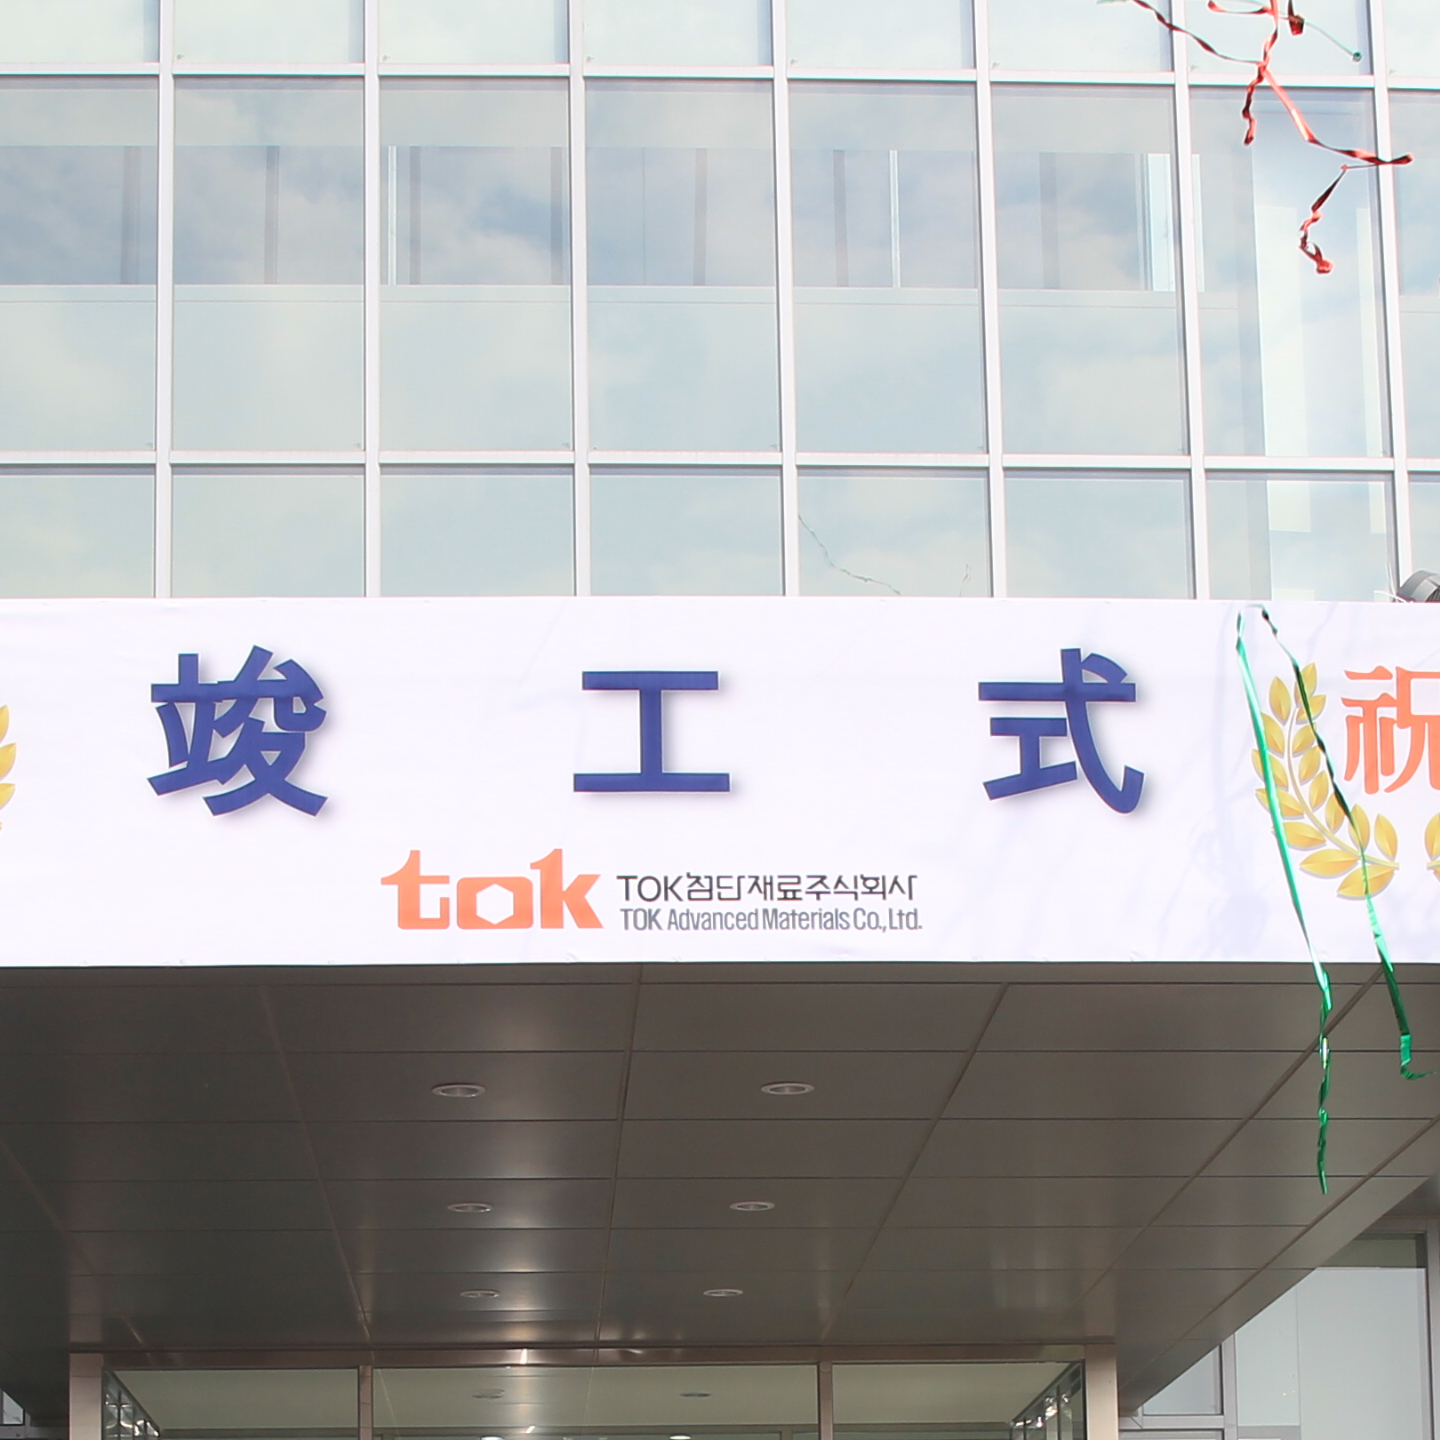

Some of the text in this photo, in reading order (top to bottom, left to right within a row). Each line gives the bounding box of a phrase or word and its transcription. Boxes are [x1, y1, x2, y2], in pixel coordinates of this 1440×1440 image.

[381, 848, 604, 930] tok
[619, 907, 663, 931] TOK
[667, 907, 759, 931] Advanced
[762, 907, 851, 931] Materials
